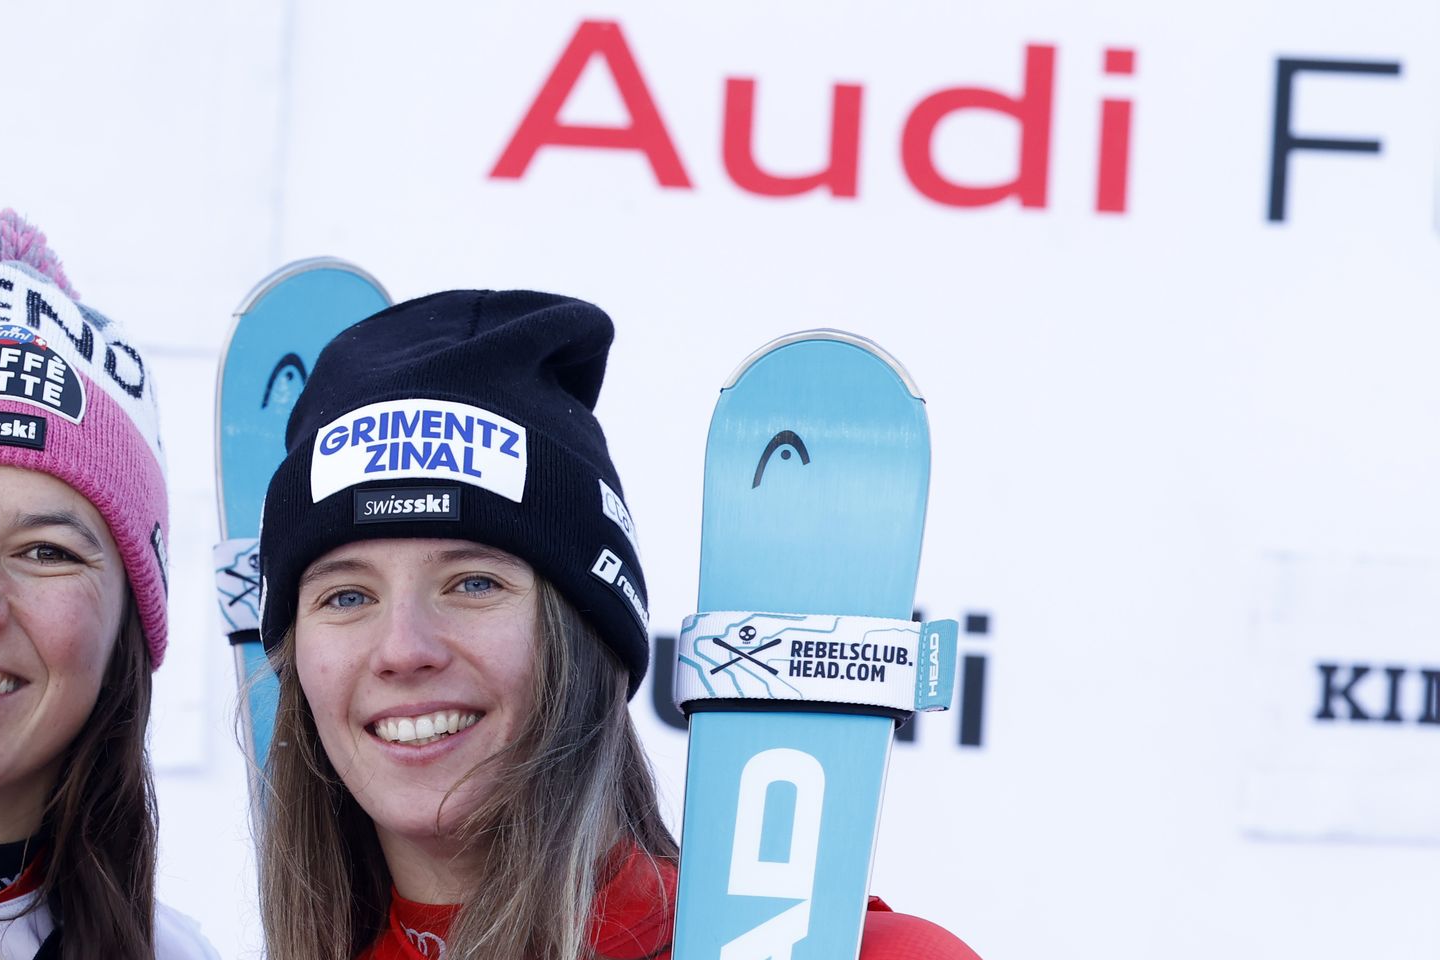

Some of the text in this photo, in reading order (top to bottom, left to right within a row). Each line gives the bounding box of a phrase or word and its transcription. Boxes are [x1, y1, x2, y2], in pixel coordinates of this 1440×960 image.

[486, 19, 1137, 214] Audi
[320, 410, 520, 458] GRIMENTZ
[364, 441, 482, 478] ZINAL
[364, 494, 450, 516] swissski
[789, 660, 885, 683] HEAD.COM
[790, 640, 913, 668] REBELSCLUB.
[926, 632, 939, 697] HEAD
